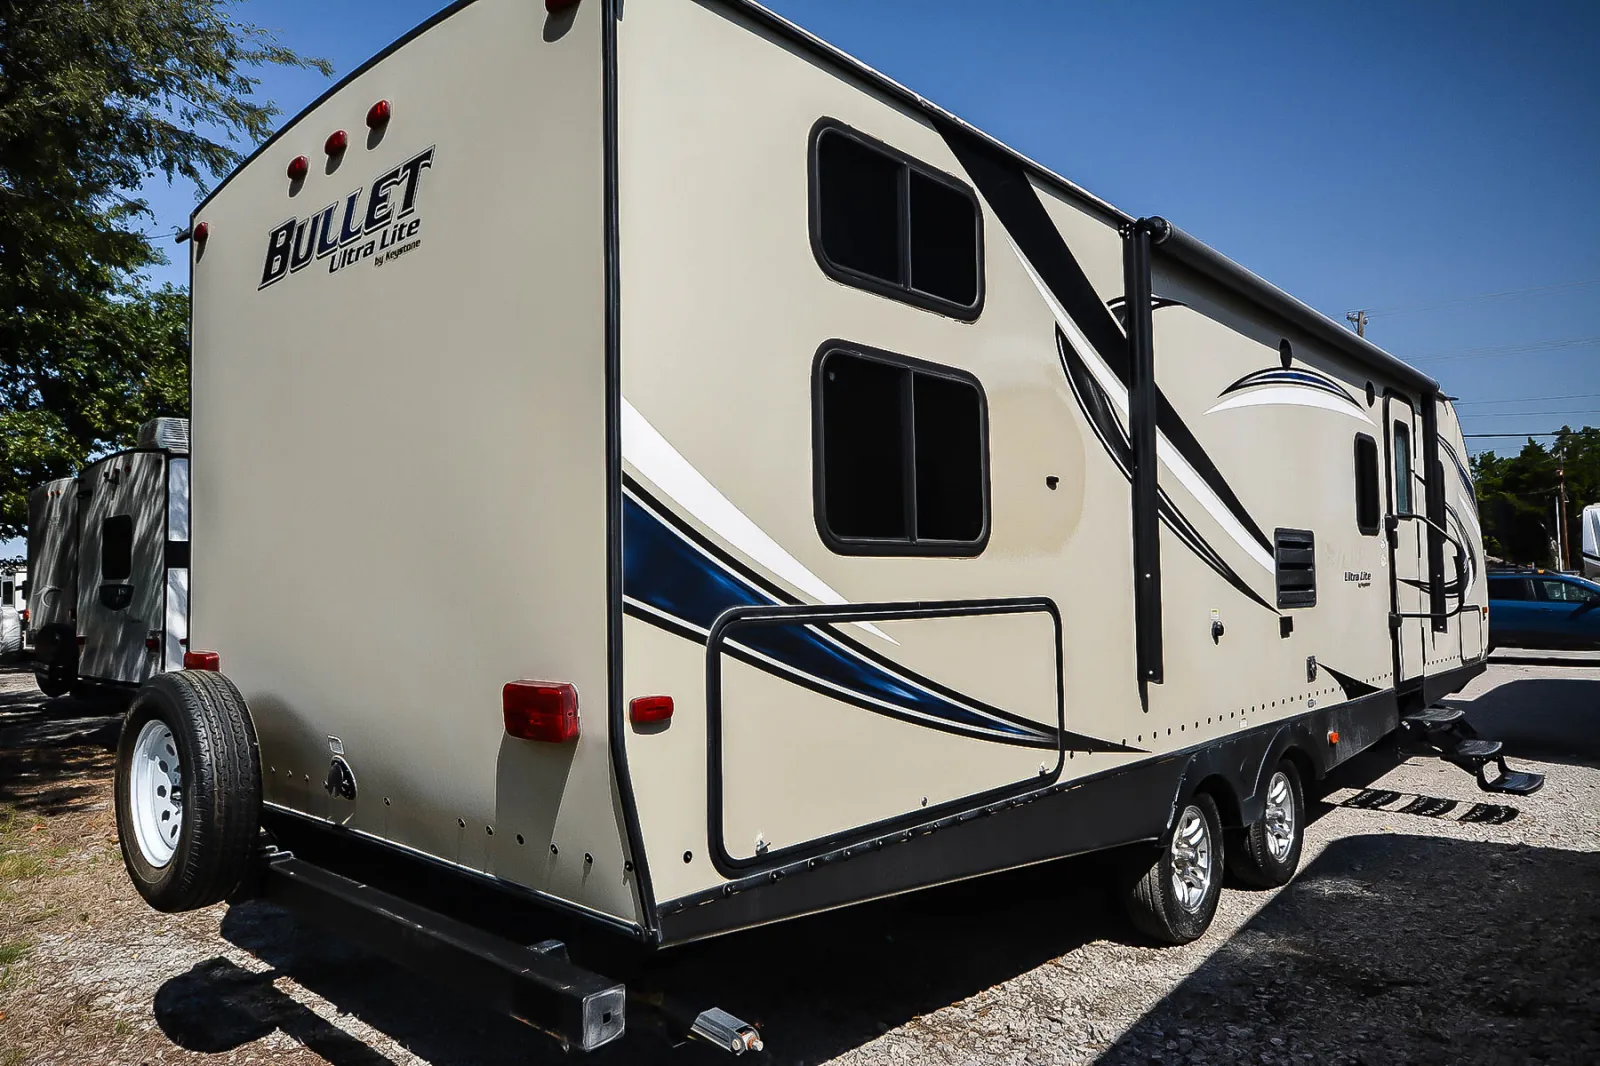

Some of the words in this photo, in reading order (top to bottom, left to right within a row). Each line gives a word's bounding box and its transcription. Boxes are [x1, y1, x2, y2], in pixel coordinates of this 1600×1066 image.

[258, 144, 436, 291] BULLET
[329, 240, 375, 273] Ultra
[379, 219, 421, 250] Lite
[374, 255, 384, 267] by
[385, 240, 421, 261] Keystone
[1344, 571, 1360, 582] Ultra
[1360, 571, 1372, 581] Lite
